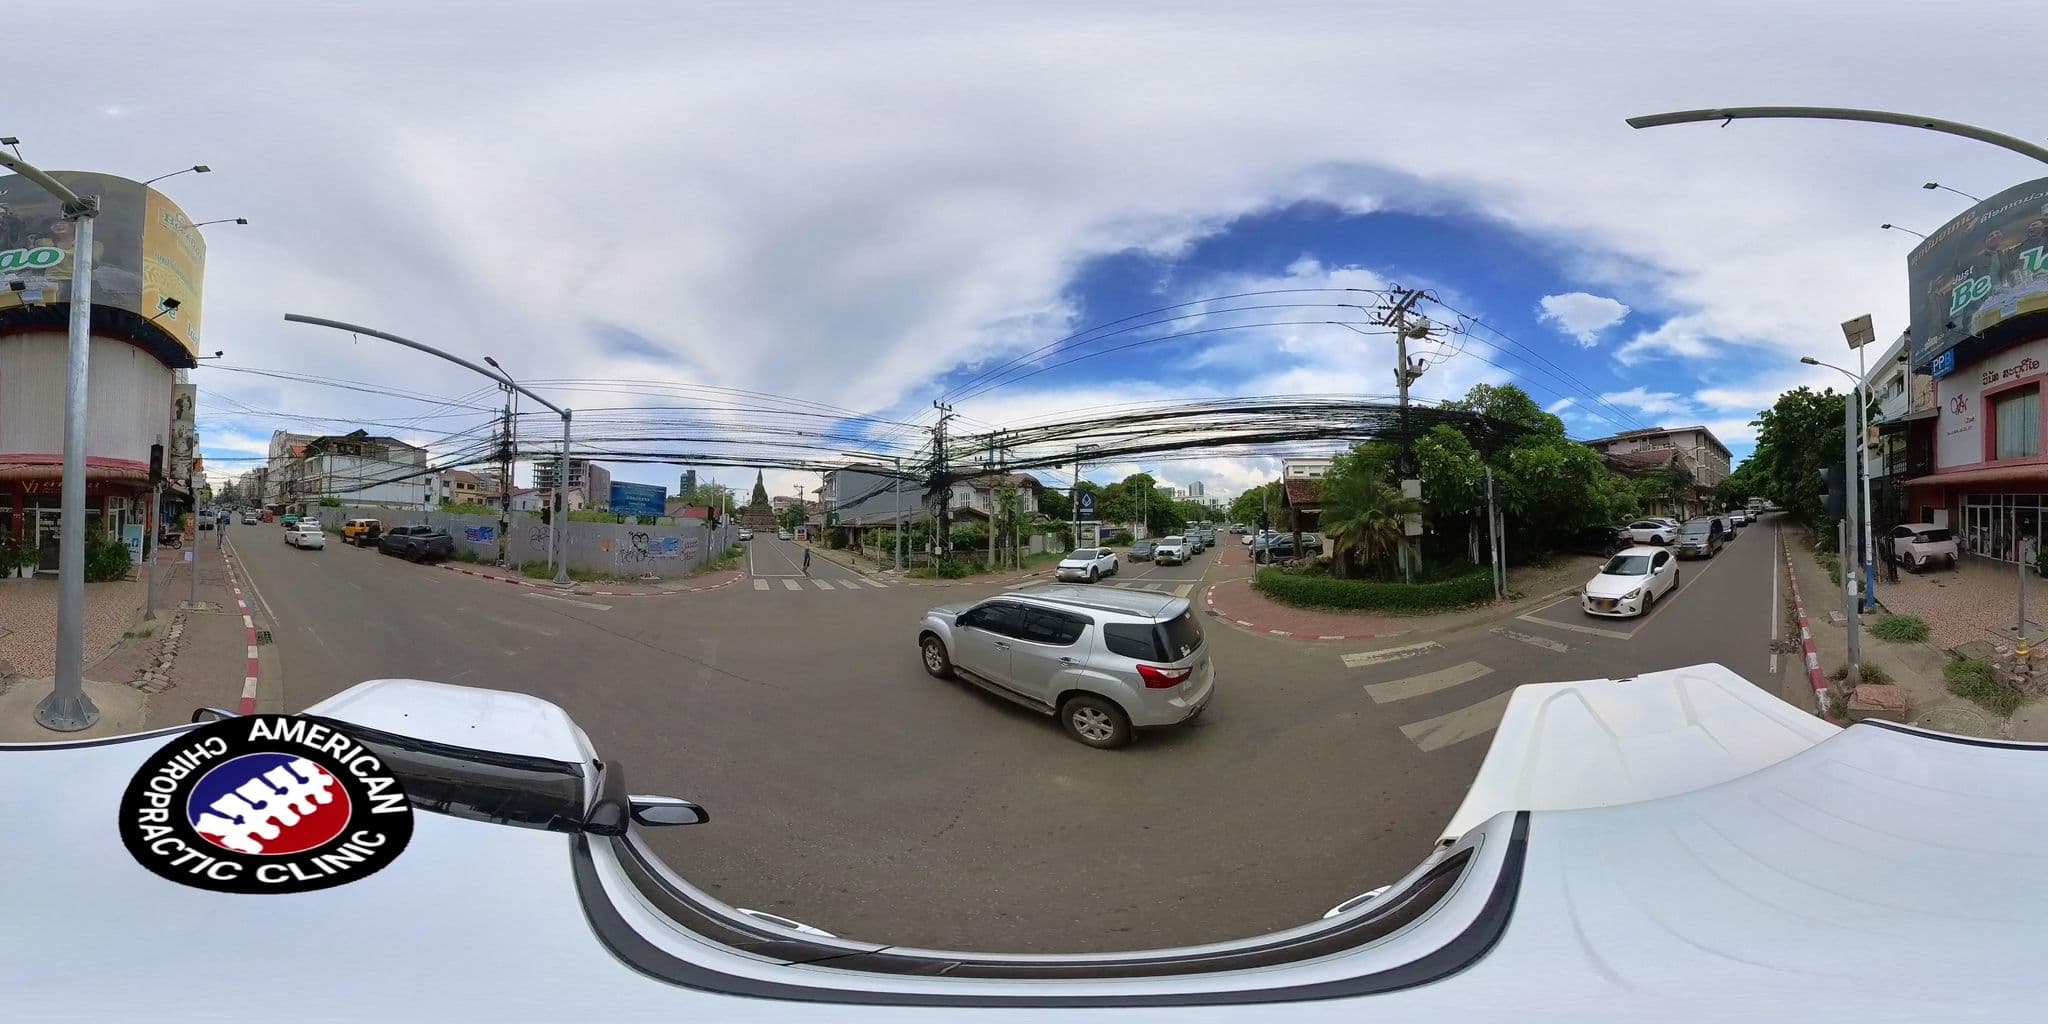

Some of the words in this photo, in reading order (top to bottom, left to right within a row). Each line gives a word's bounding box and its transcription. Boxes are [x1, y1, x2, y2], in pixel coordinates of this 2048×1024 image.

[1952, 265, 1975, 285] Just
[1950, 275, 1992, 316] Be
[1933, 351, 1951, 372] PPB
